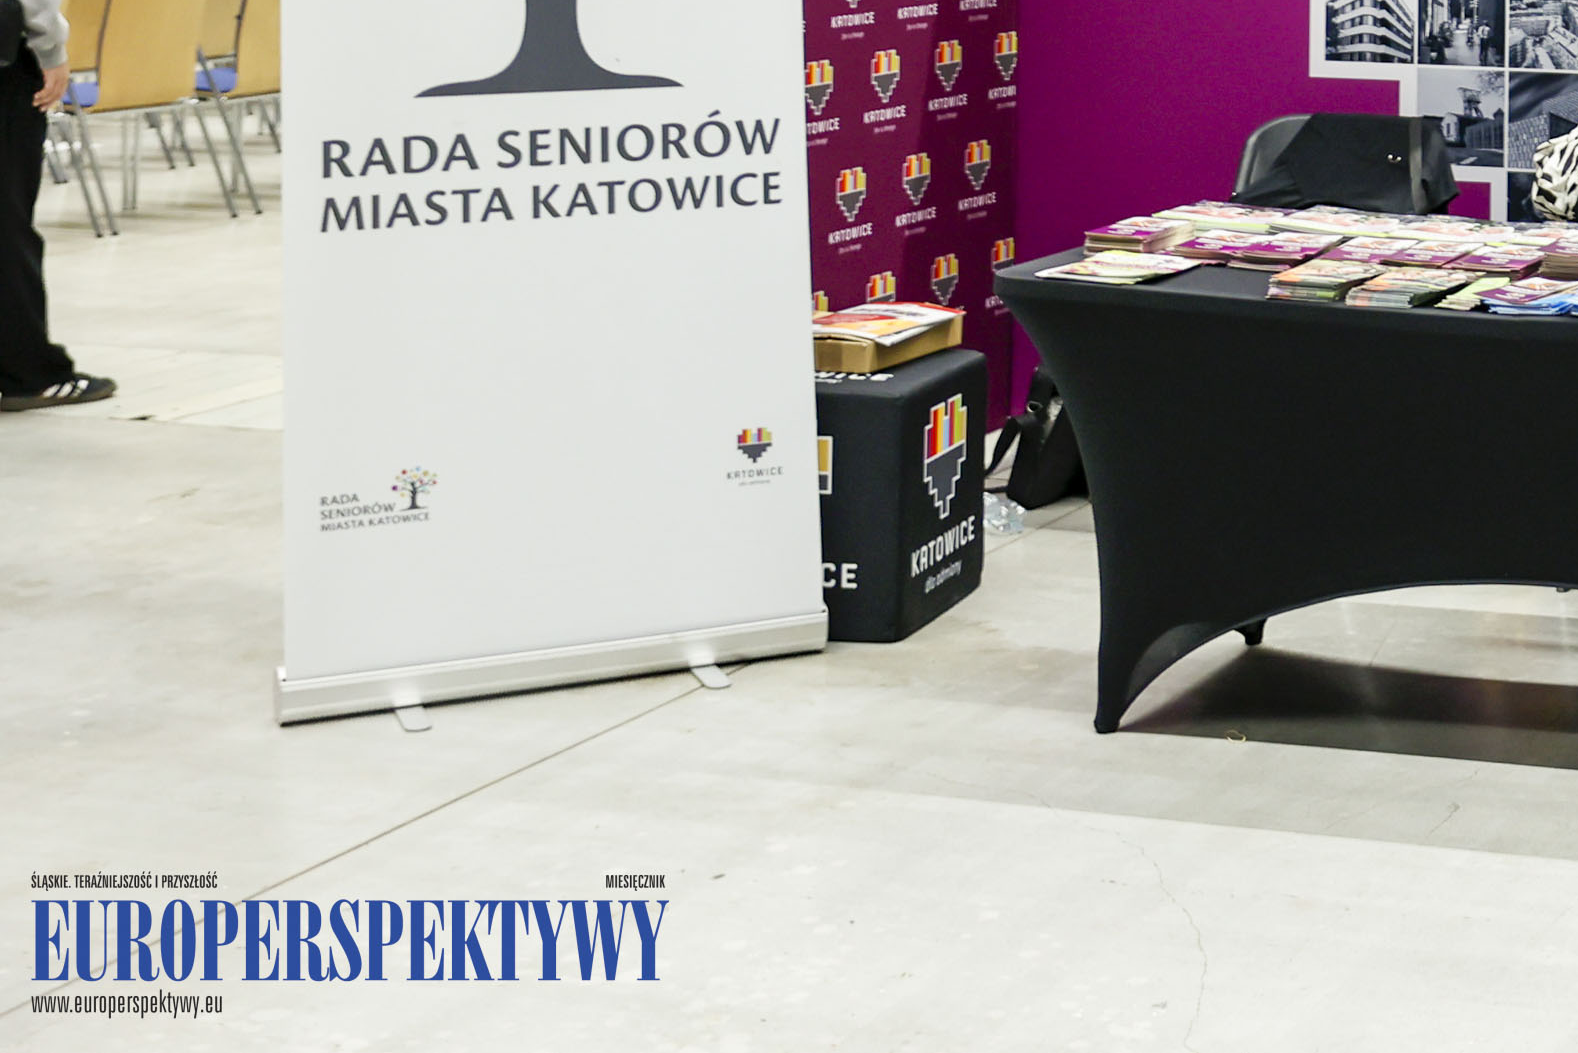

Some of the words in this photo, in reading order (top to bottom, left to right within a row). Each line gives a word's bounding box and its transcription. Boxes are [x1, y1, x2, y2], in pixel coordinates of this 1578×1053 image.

[830, 11, 875, 29] KATOWICE
[897, 3, 938, 20] KATOWICE
[928, 93, 968, 112] KATOWICE
[863, 104, 907, 124] KATOWICE
[321, 133, 479, 178] RADA
[497, 109, 781, 169] SENIORÓW
[320, 187, 515, 233] MIASTA
[532, 171, 783, 219] KATOWICE
[958, 191, 997, 211] KATOWICE
[895, 206, 937, 228] KATOWICE
[828, 222, 873, 245] KATOWICE
[727, 466, 784, 480] KATOWICE
[320, 493, 360, 507] RADA
[320, 501, 396, 520] SENIORÓW
[320, 519, 365, 532] MIASTA
[368, 512, 430, 527] KATOWICE
[910, 514, 976, 579] KATOWICE
